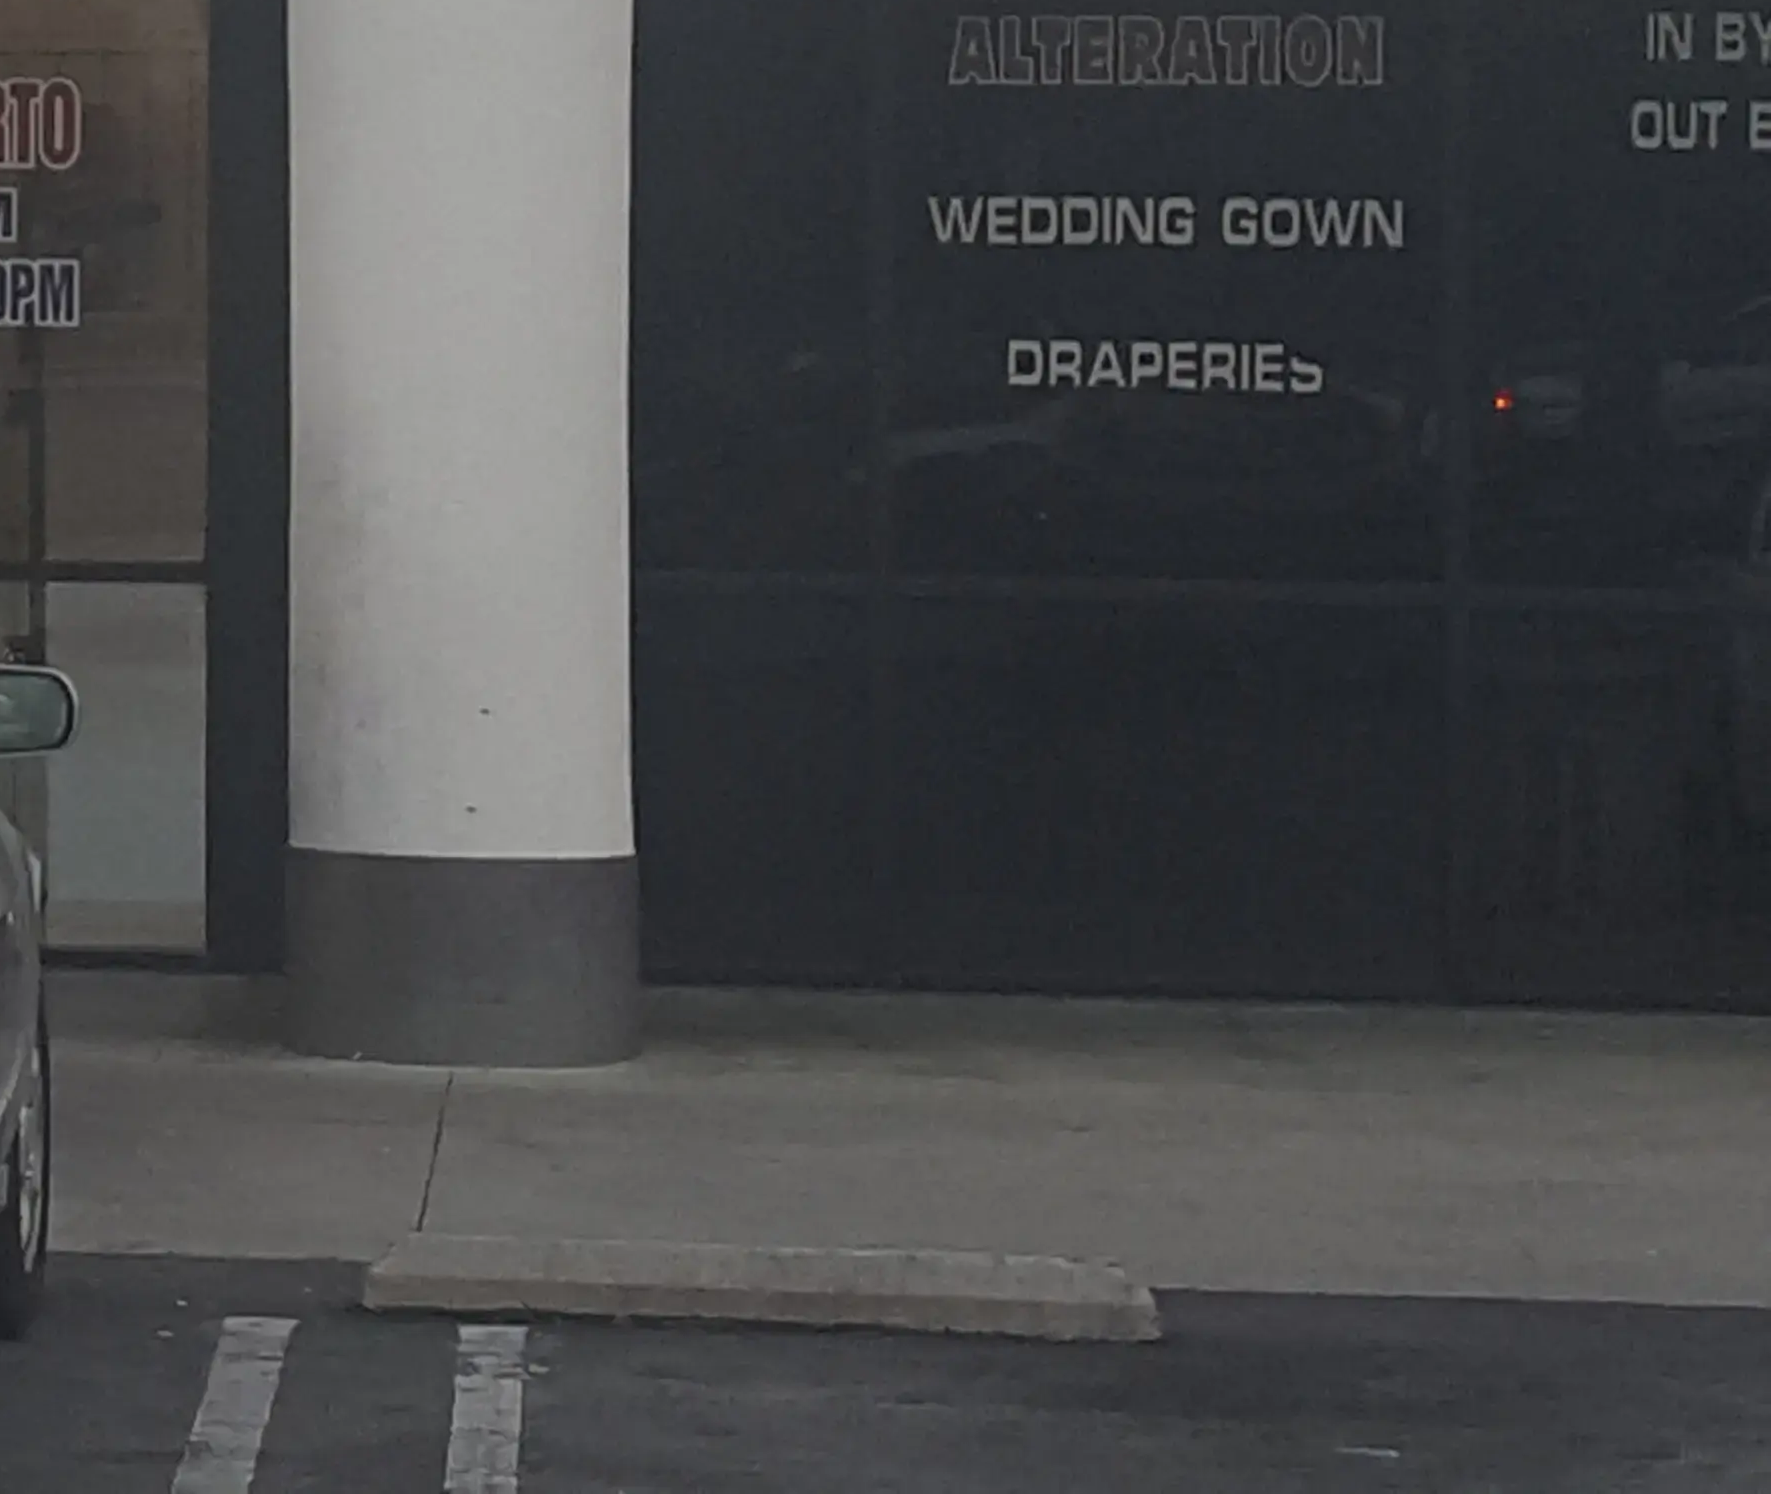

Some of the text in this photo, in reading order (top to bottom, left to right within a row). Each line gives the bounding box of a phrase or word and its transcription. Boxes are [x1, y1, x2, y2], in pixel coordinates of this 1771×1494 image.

[948, 15, 1385, 88] ALTERATION
[1645, 11, 1771, 66] IN BY
[1631, 100, 1729, 150] OUT
[928, 196, 1405, 249] WEDDING GOWN
[1007, 339, 1323, 394] DRAPERIES
